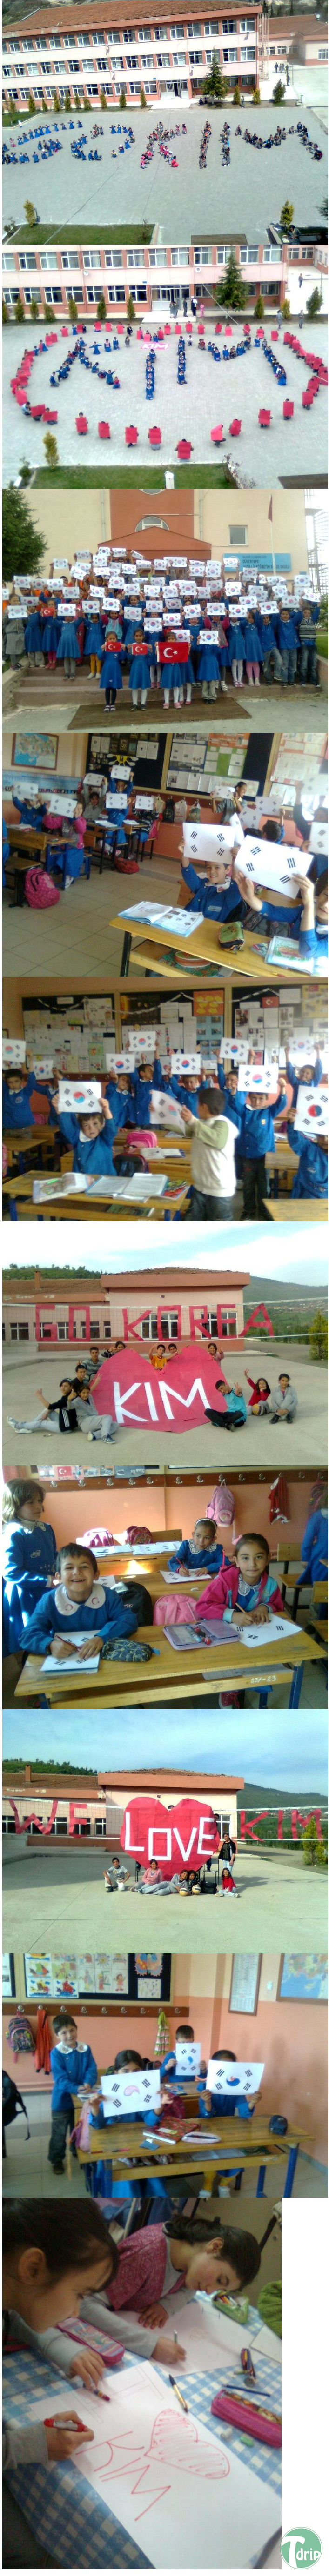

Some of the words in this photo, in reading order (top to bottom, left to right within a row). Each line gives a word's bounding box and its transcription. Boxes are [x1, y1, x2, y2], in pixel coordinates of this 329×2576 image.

[35, 1304, 90, 1342] GO
[122, 1303, 275, 1342] KOREA
[114, 1378, 211, 1424] KIM
[8, 1799, 87, 1839] WE
[124, 1812, 215, 1862] LOVE
[240, 1809, 323, 1842] KIM
[75, 2431, 172, 2521] KIM
